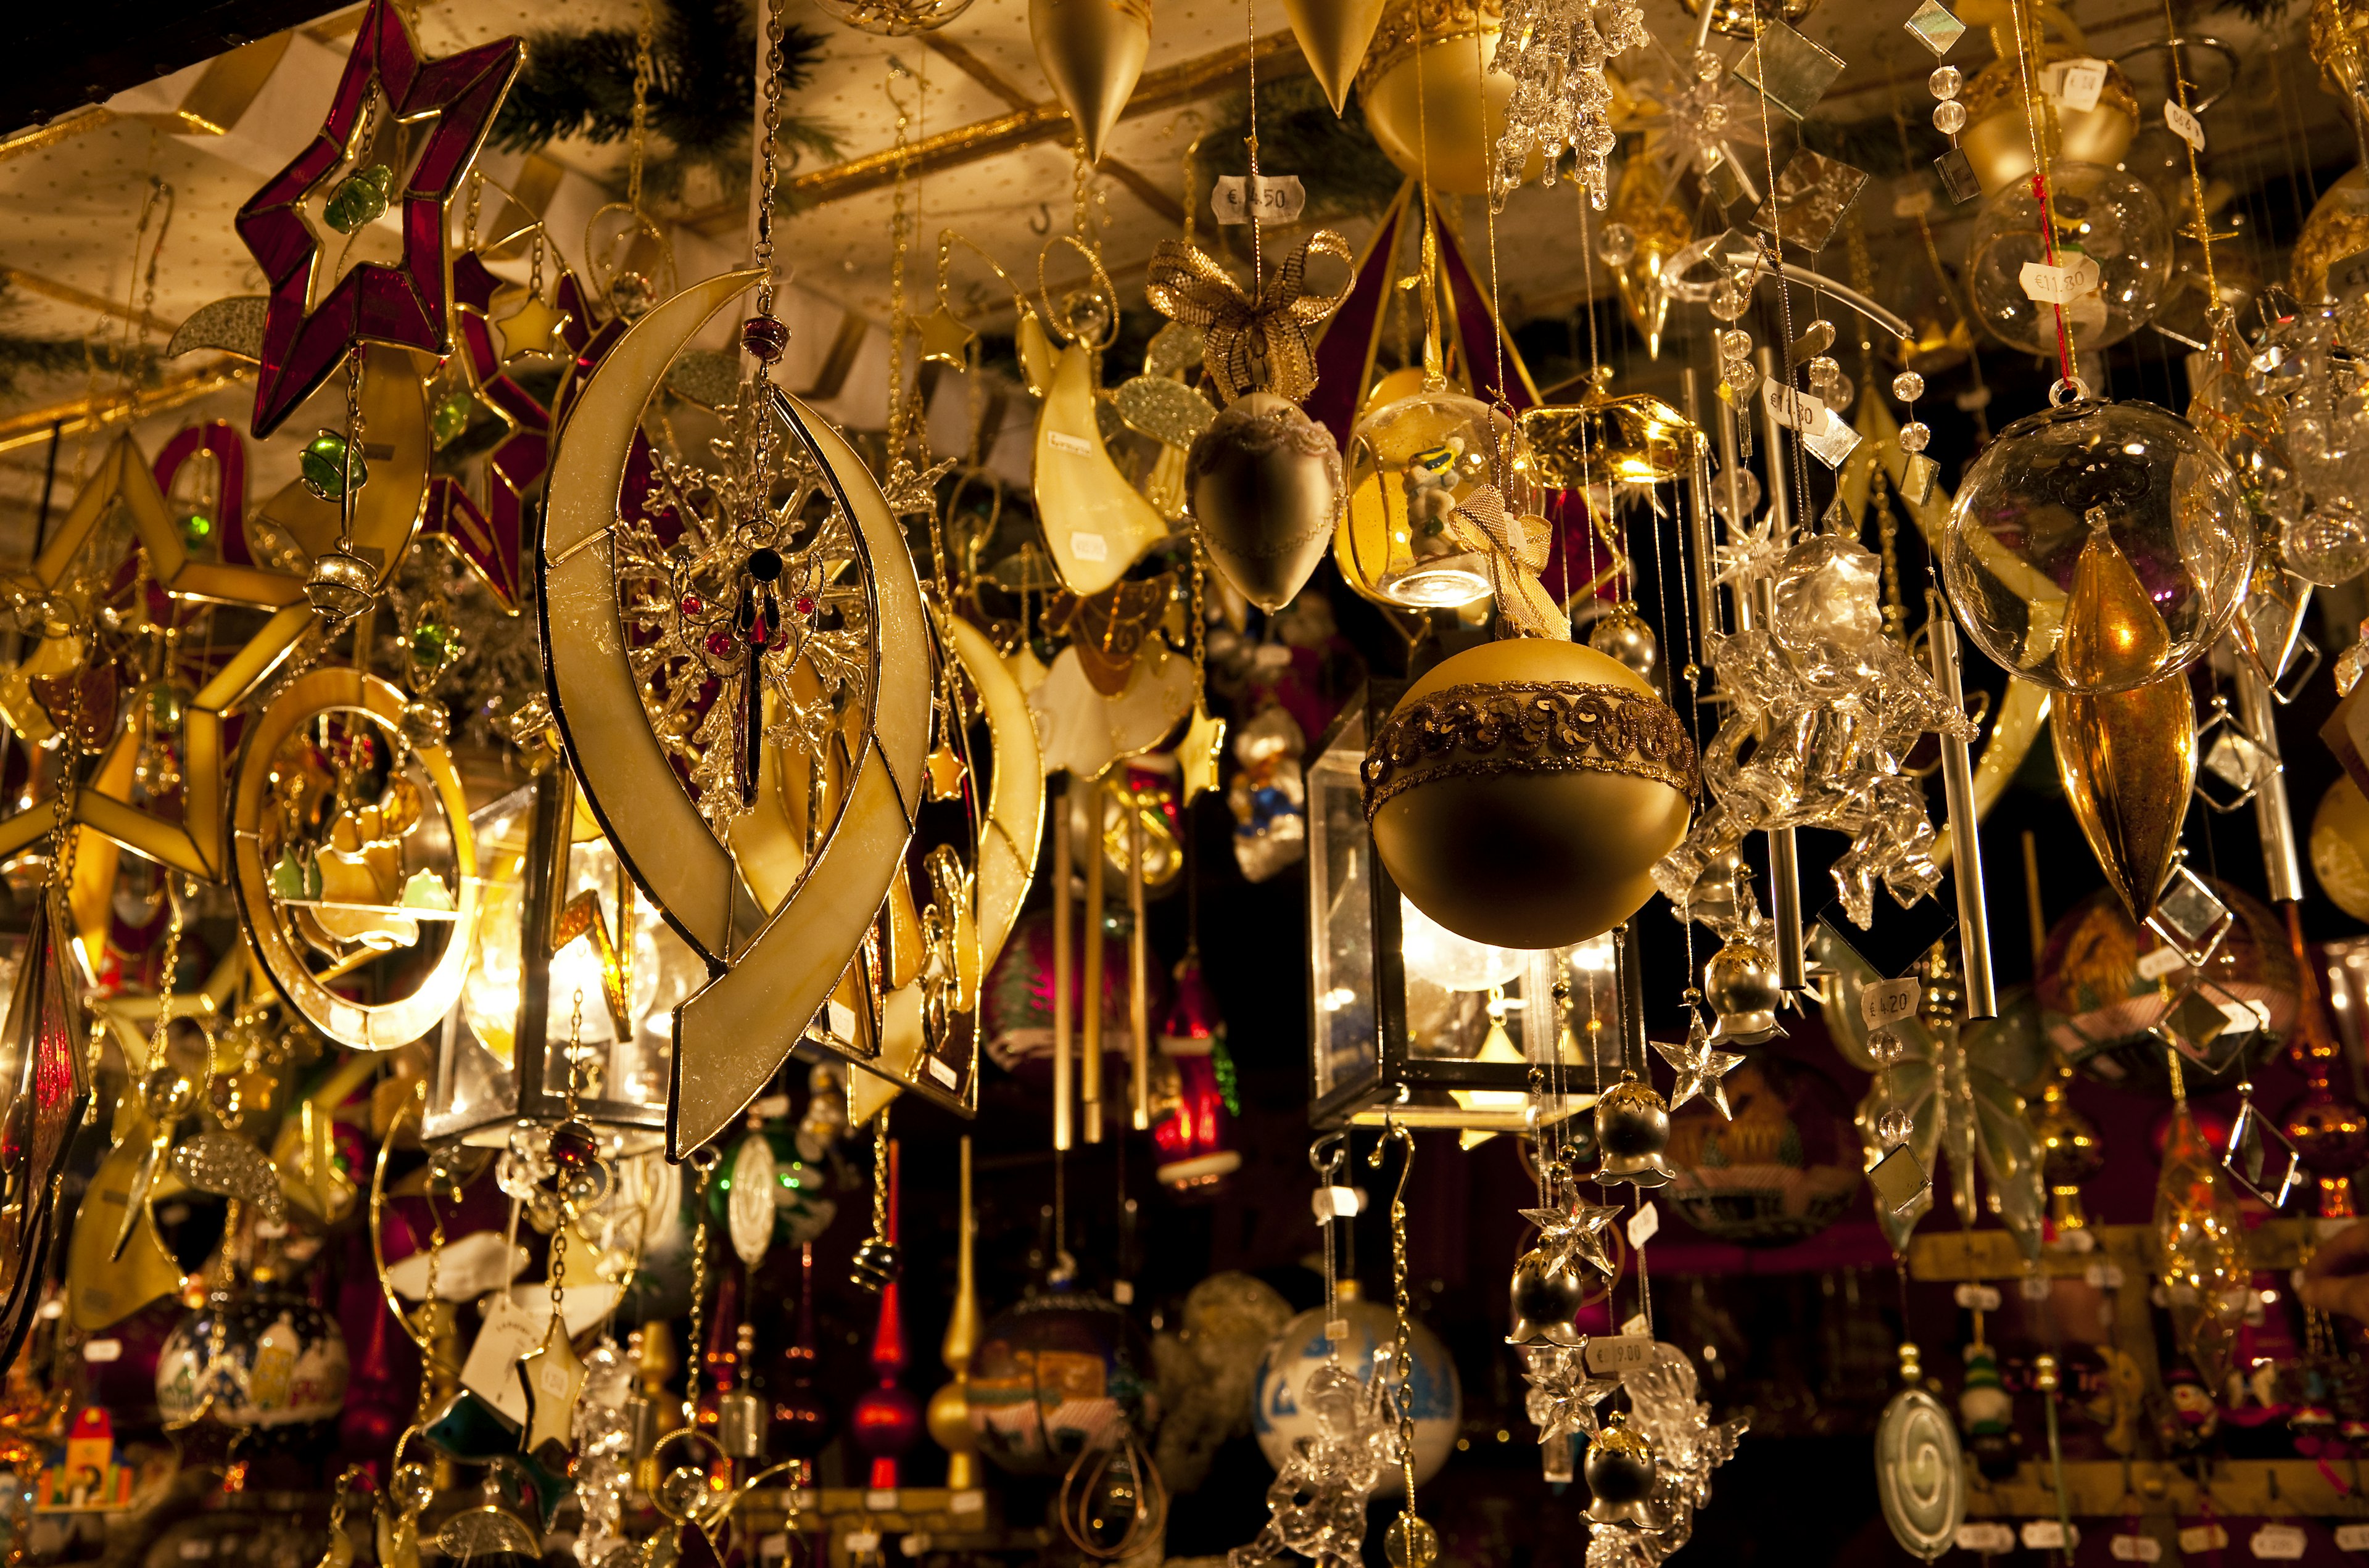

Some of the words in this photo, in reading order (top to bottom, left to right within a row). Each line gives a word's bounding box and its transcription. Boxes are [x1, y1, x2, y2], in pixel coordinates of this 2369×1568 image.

[1251, 188, 1285, 208] 4.50
[2035, 271, 2085, 292] €11.80
[1880, 993, 1907, 1015] 4.20
[1617, 1345, 1641, 1362] 9.00
